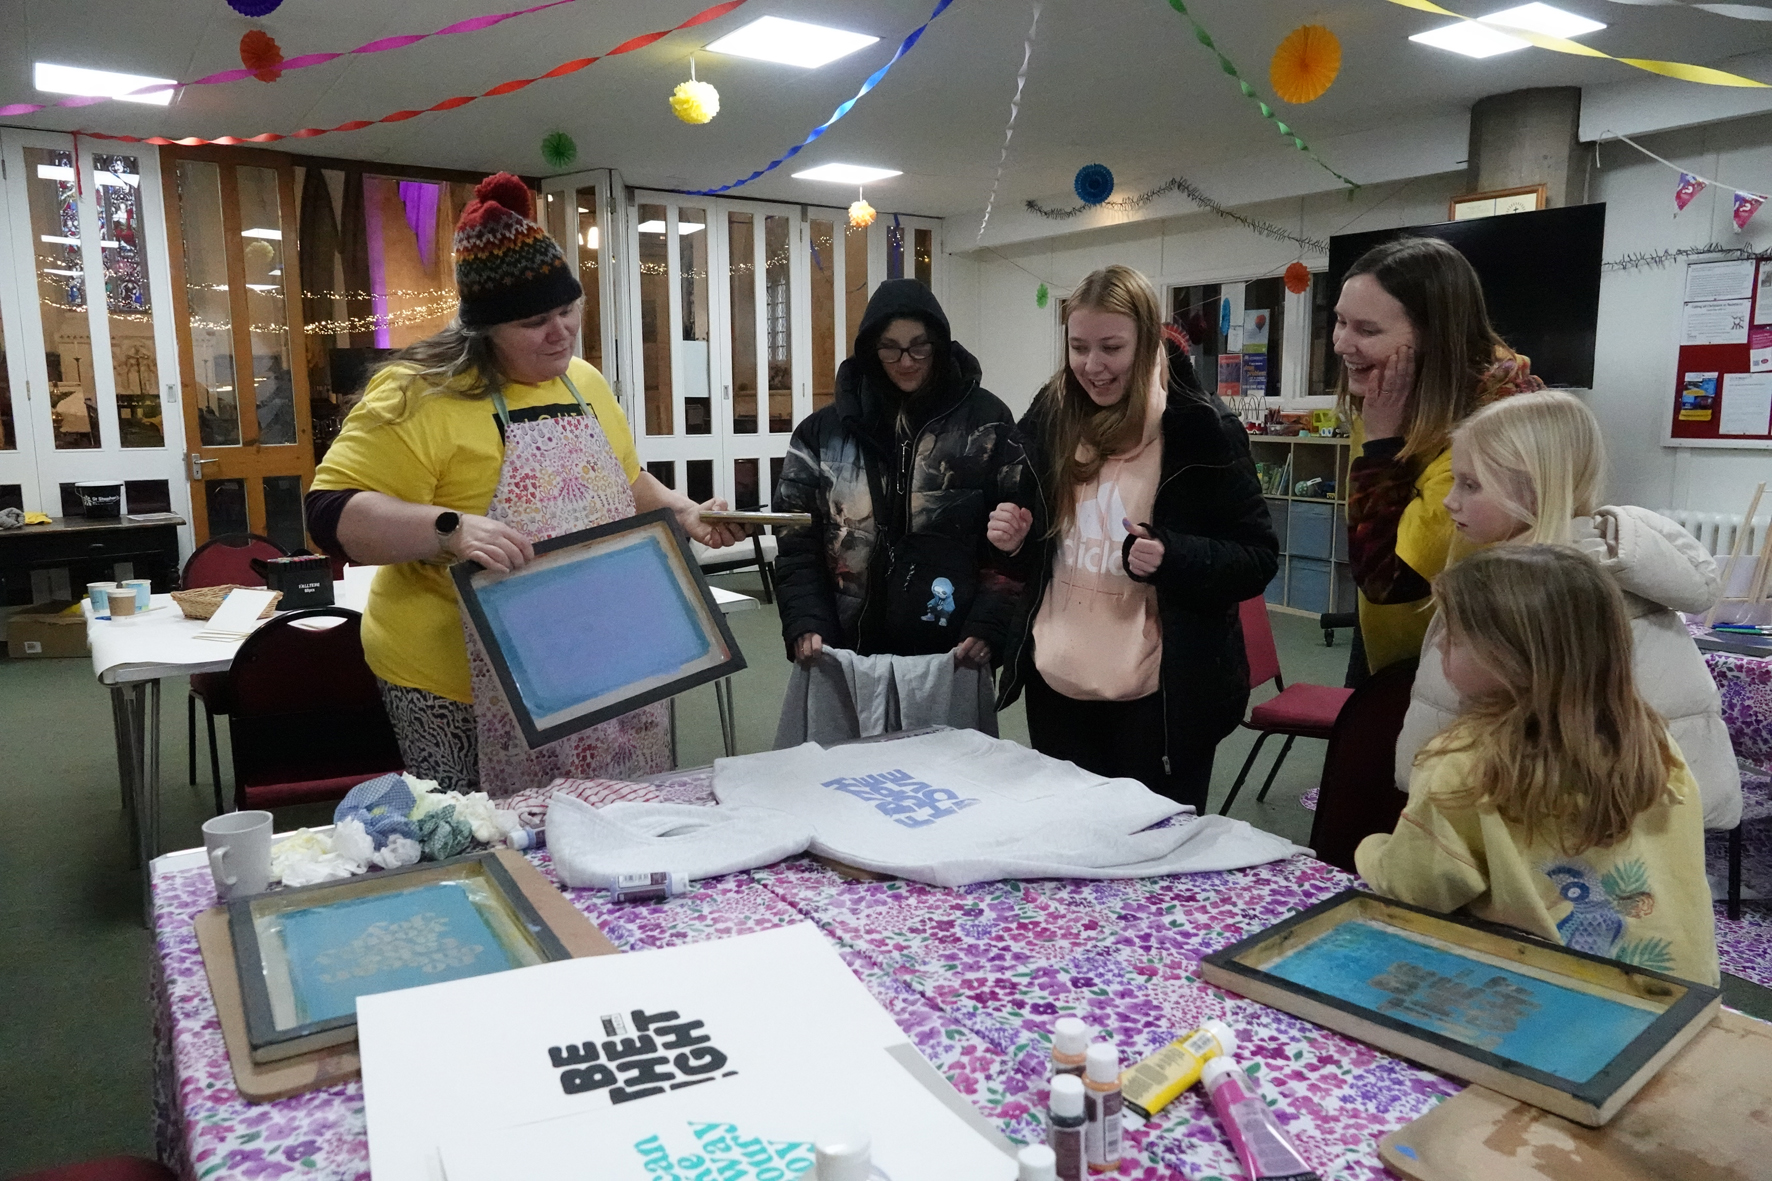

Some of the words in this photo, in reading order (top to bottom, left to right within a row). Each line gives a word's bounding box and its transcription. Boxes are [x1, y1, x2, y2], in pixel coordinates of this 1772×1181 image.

[820, 777, 937, 829] FAITH
[848, 774, 960, 820] HOPE
[885, 768, 982, 811] LOVE
[549, 1041, 618, 1095] BE
[687, 1120, 748, 1181] way
